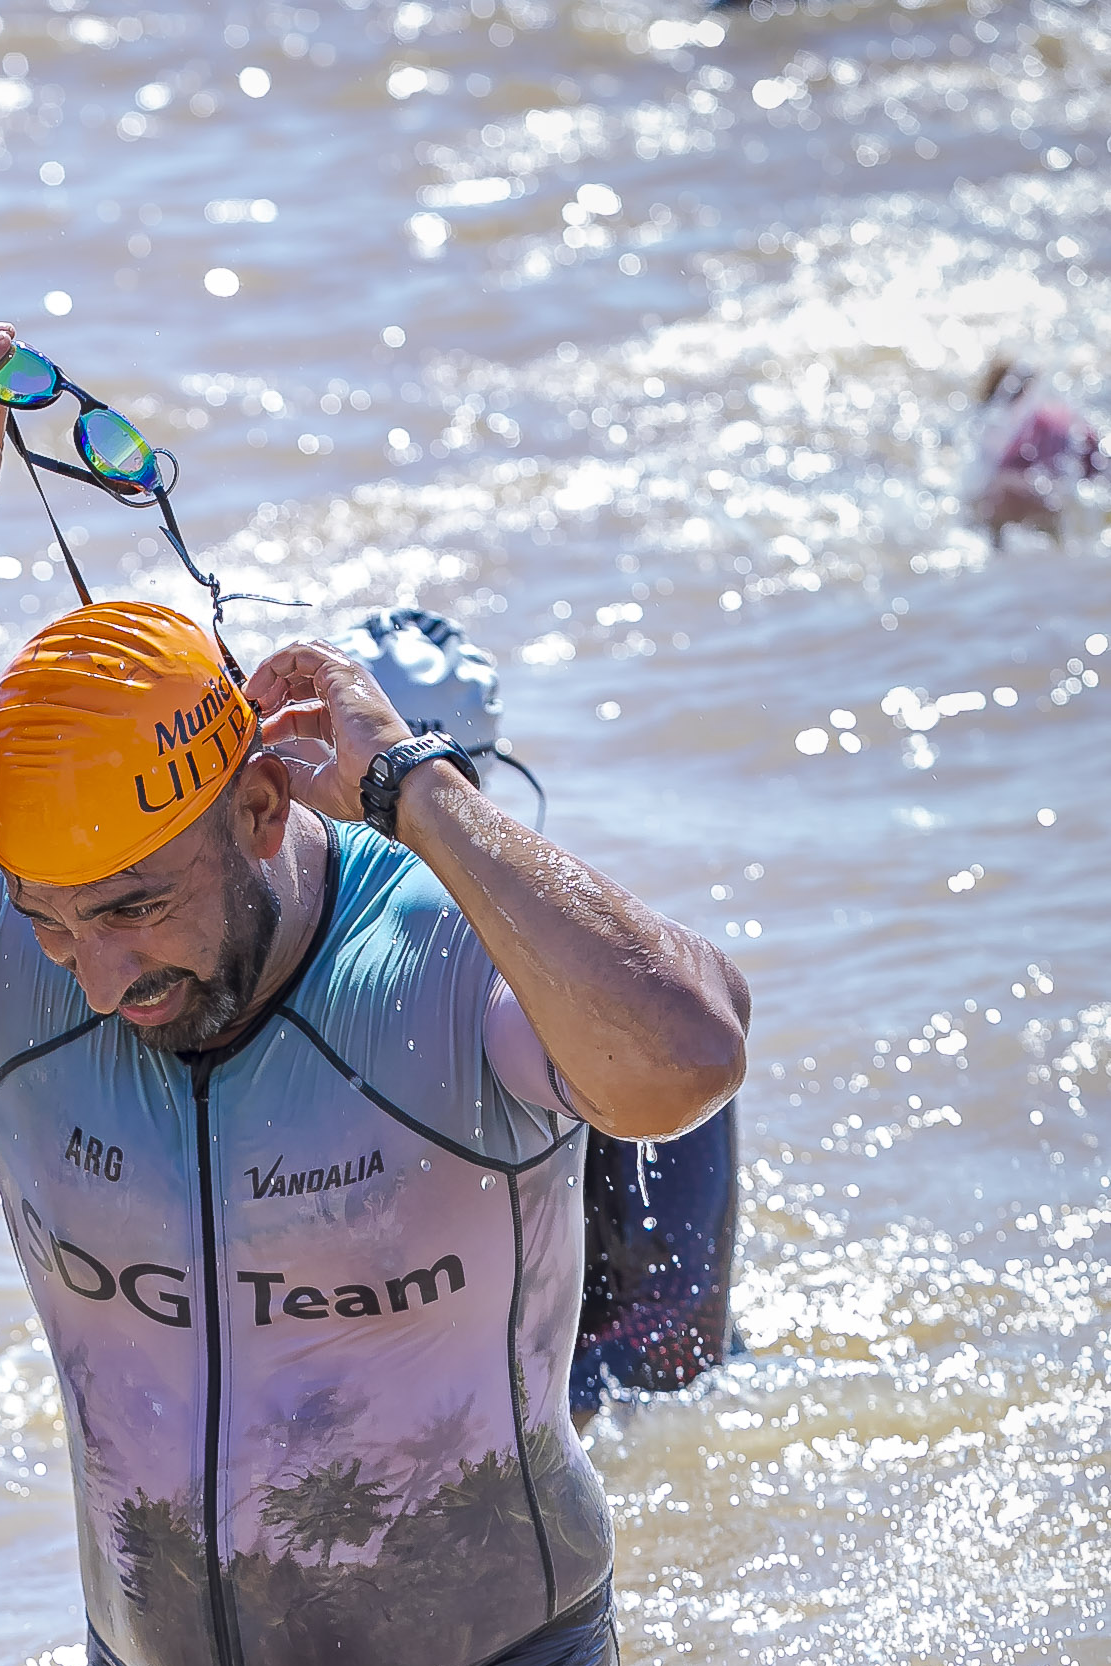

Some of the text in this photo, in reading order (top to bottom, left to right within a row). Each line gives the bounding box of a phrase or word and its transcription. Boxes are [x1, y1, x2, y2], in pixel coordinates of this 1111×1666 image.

[65, 1126, 123, 1182] ARG
[243, 1150, 385, 1200] VANDALIA
[22, 1198, 466, 1328] SDG Team
